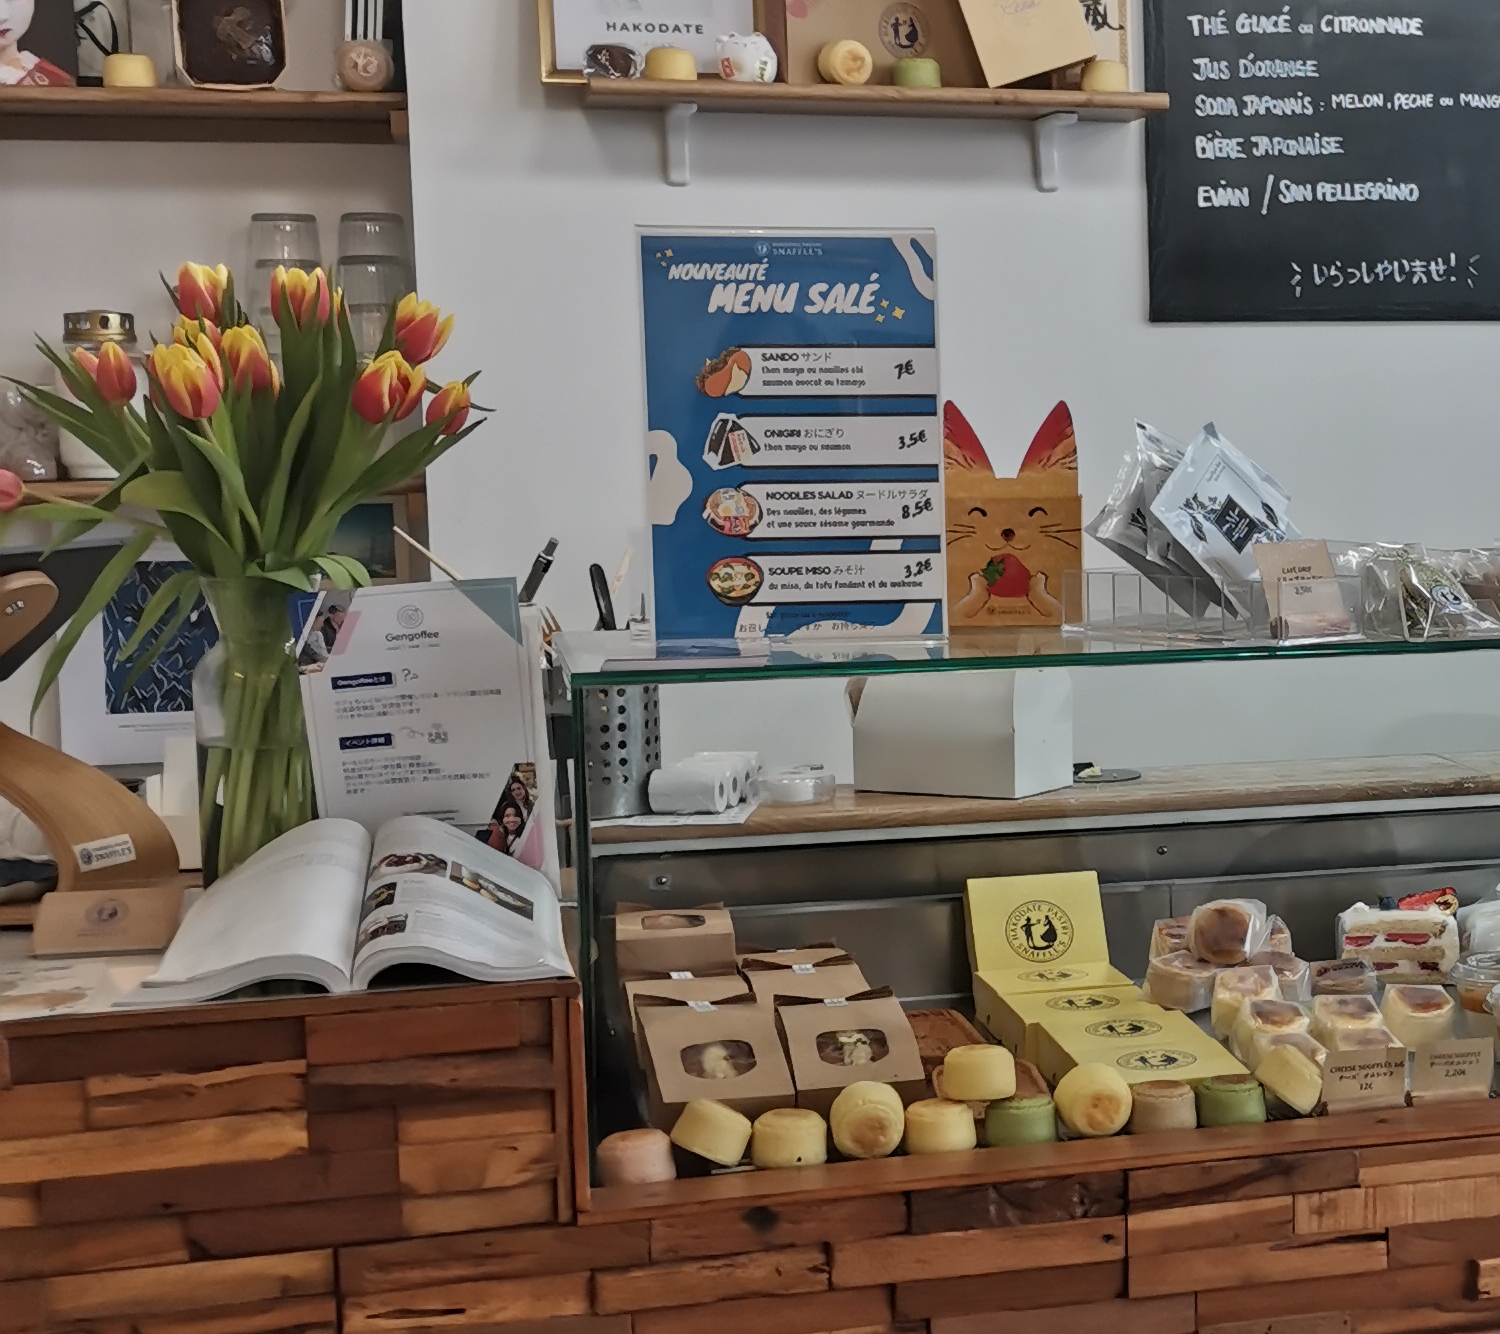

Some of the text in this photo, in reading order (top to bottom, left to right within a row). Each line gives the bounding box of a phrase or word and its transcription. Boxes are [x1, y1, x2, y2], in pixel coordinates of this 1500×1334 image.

[1187, 8, 1230, 37] THÉ
[1235, 4, 1293, 35] GLACÉ
[1321, 15, 1424, 36] CITRONNADE
[605, 21, 704, 35] HAKODATE
[1192, 57, 1231, 82] JUS
[1195, 94, 1239, 118] SODA
[1197, 179, 1250, 209] EVIAN
[1316, 177, 1420, 203] PELLEGRINO
[667, 257, 770, 282] NOUVEAUTÉ
[707, 272, 881, 315] MENU SALÉ
[761, 352, 800, 362] SANDO
[801, 351, 832, 363] サンド
[894, 358, 916, 381] 7€
[803, 427, 845, 439] おにぎり
[766, 489, 854, 500] NOODLES SALAD
[855, 488, 929, 500] ヌードルサラダ
[767, 565, 832, 577] SOUPE MISO
[384, 629, 440, 643] Gengoffee
